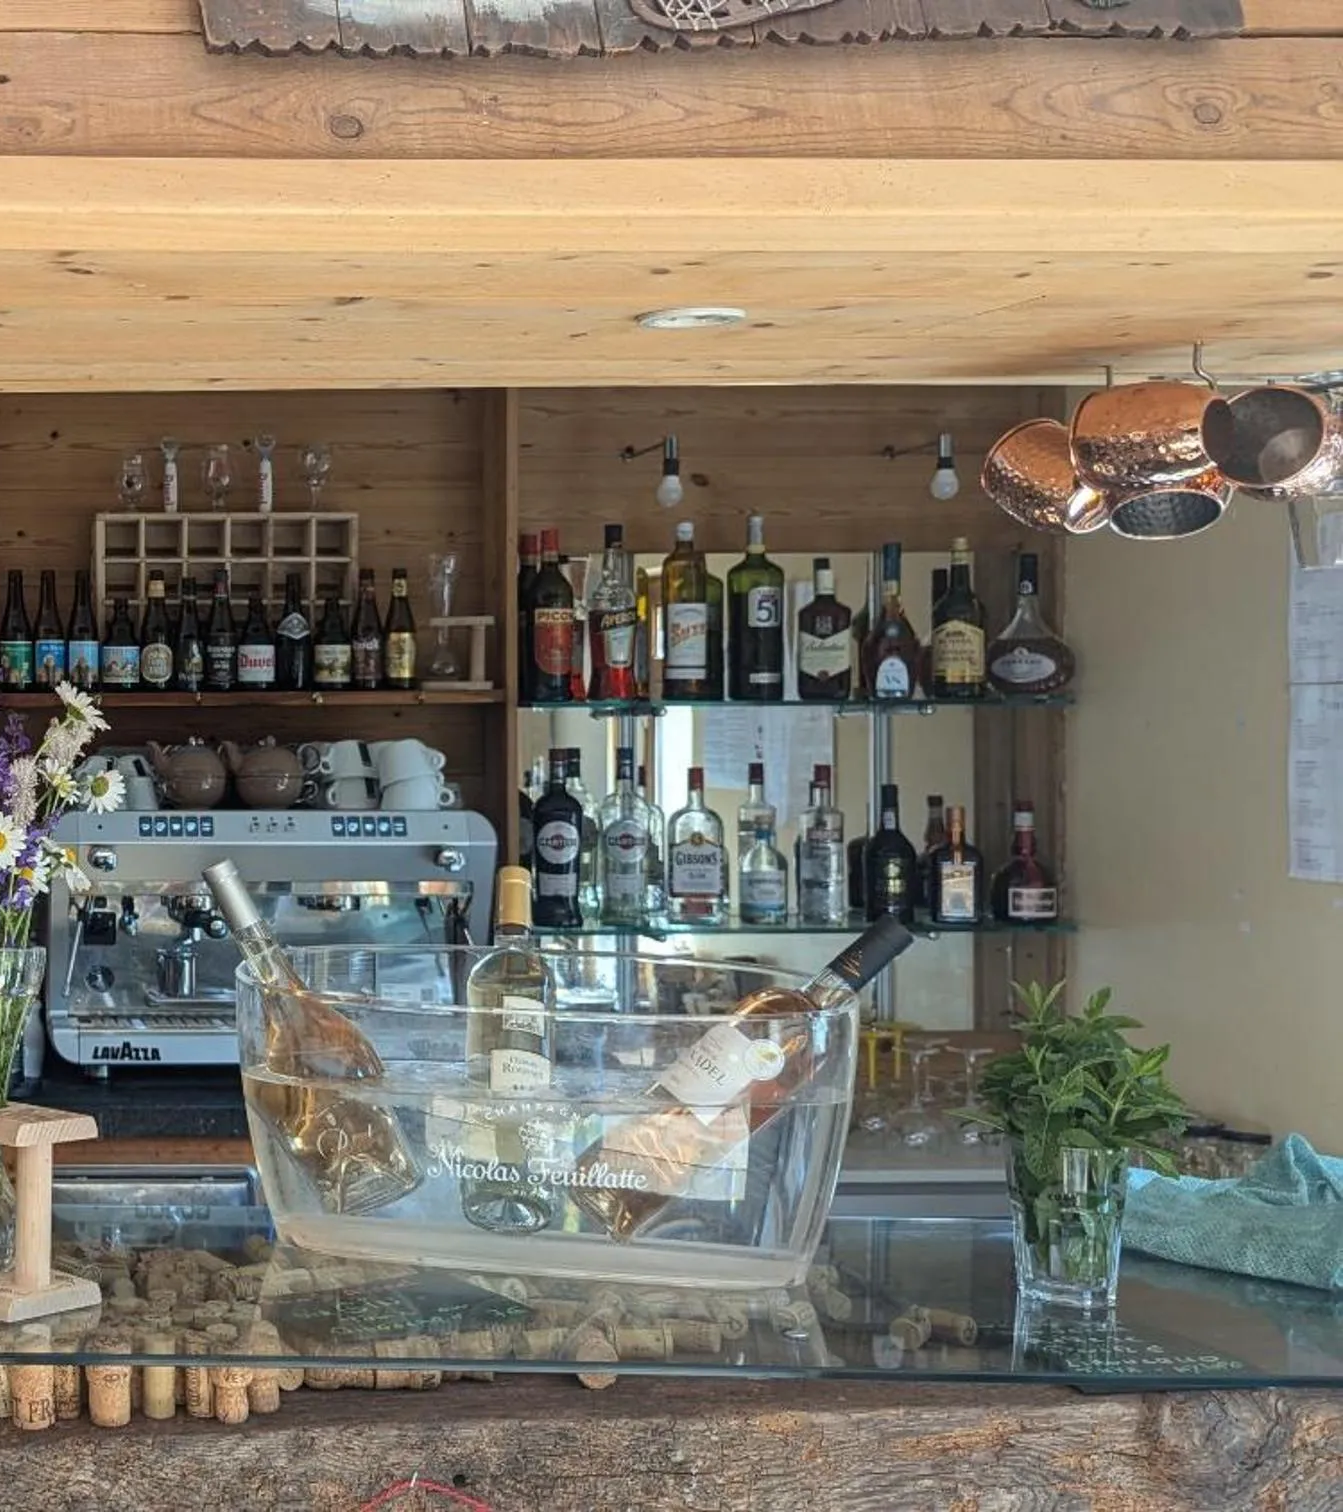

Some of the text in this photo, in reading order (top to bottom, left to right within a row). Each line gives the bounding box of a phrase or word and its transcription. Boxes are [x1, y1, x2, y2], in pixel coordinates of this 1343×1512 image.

[92, 1041, 161, 1061] LAVAZZA
[427, 1140, 649, 1191] Nicolas Feuillatte
